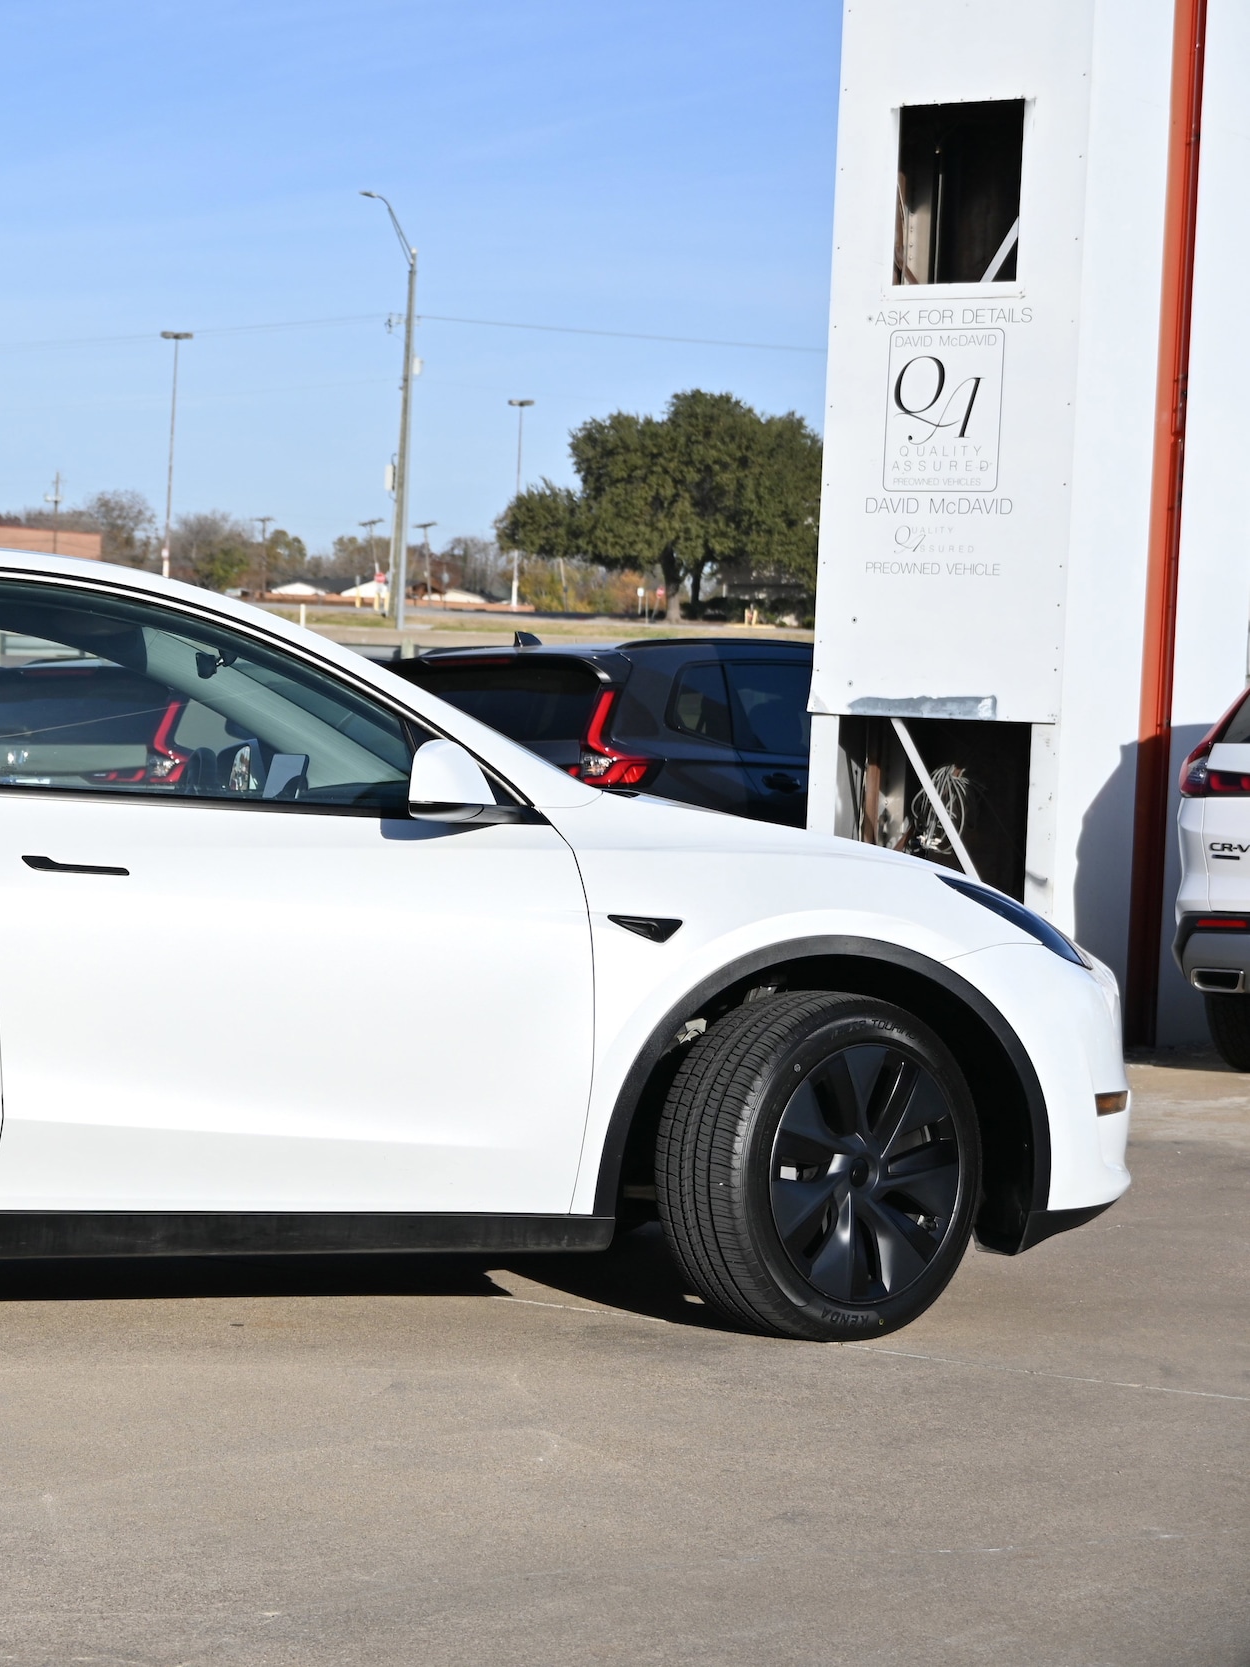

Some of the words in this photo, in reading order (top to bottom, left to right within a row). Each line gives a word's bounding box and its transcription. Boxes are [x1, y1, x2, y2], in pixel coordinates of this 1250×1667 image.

[918, 309, 954, 325] FOR
[962, 307, 1033, 324] DETAILS
[894, 335, 933, 348] DAVID
[939, 334, 997, 347] McDAVID
[899, 446, 982, 457] QUALITY
[891, 460, 989, 472] ASSURED
[892, 478, 939, 486] PREOWNED
[943, 478, 981, 486] VEHICLES
[865, 497, 919, 514] DAVID
[929, 498, 1013, 515] McDAVID
[865, 562, 941, 575] PREOWNED
[946, 563, 1001, 576] VEHICLE
[1209, 842, 1250, 853] CR-V
